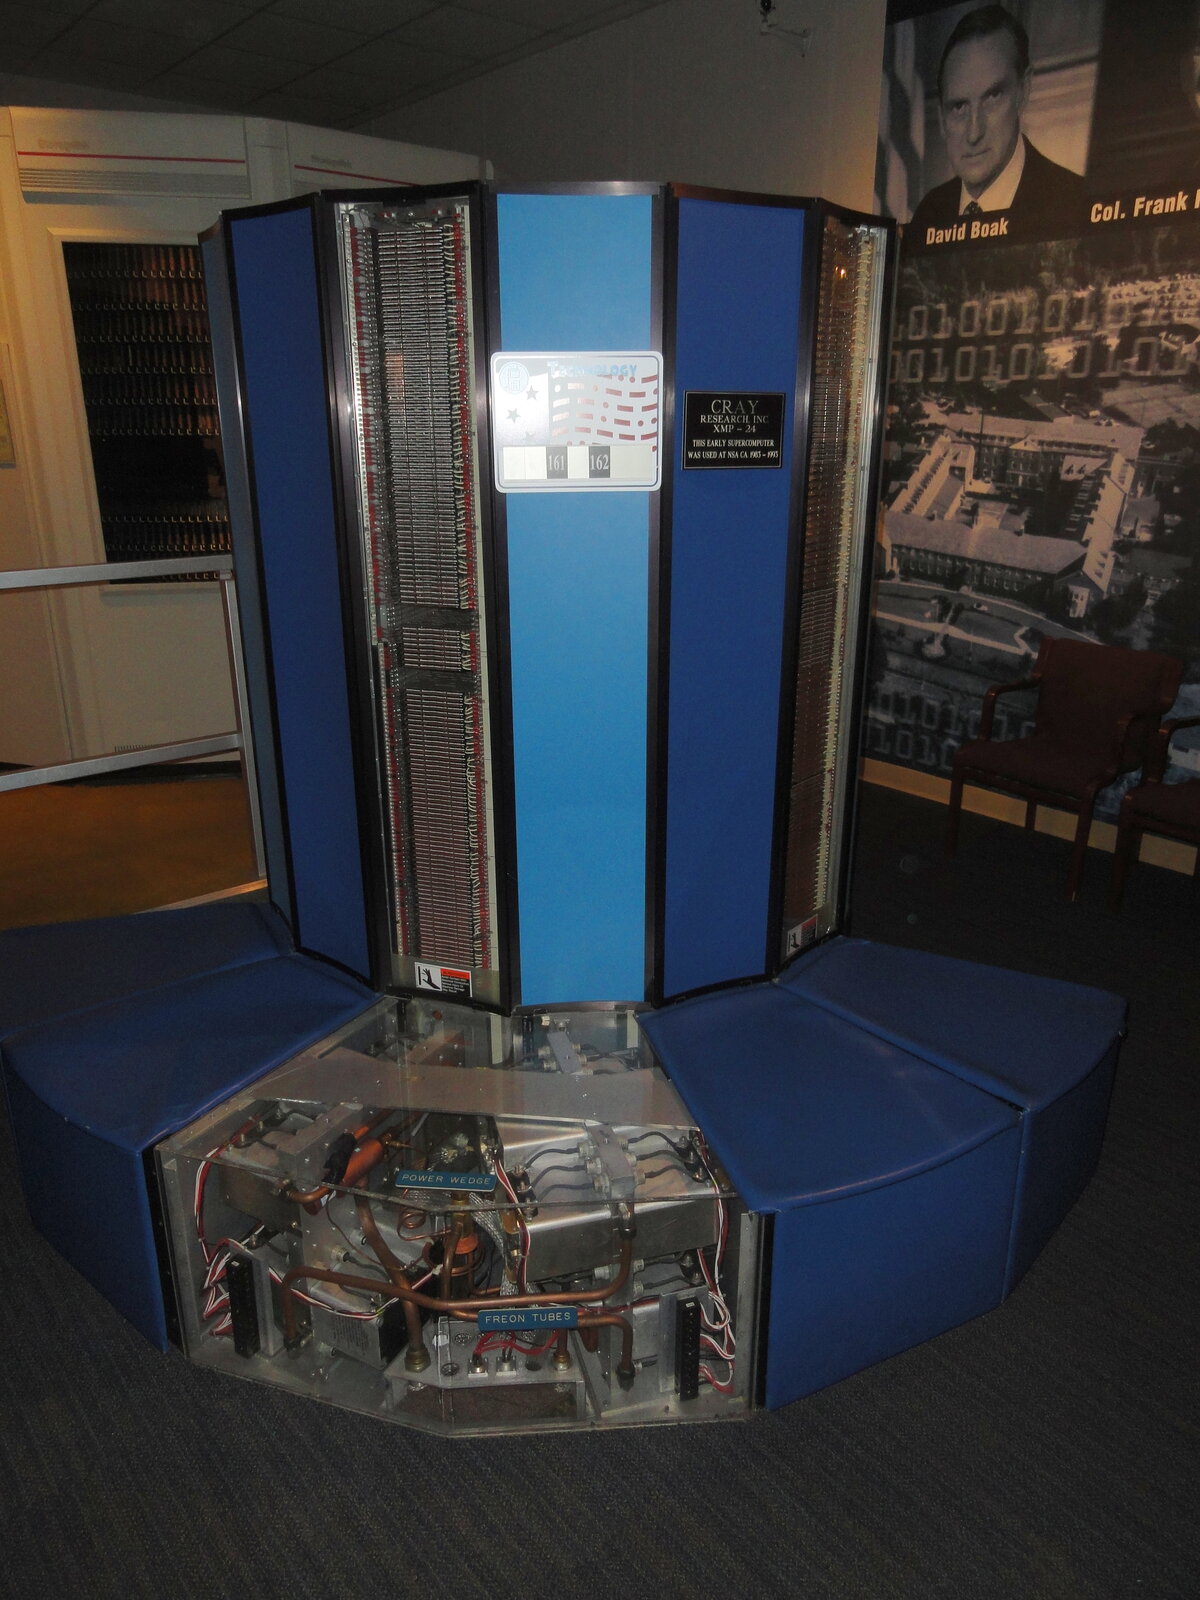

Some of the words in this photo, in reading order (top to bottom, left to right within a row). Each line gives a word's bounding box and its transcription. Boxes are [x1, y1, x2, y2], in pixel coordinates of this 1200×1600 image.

[1090, 200, 1126, 223] Col.
[1133, 190, 1189, 217] Frank
[926, 222, 967, 245] David
[970, 217, 1009, 239] Boak
[711, 399, 759, 414] CRAY
[700, 414, 750, 424] RESEARCH
[753, 415, 769, 424] INC
[713, 424, 734, 433] XMP
[745, 424, 756, 433] 24
[693, 439, 706, 448] THIS
[707, 439, 726, 447] EARLY
[590, 454, 609, 470] 162
[688, 451, 701, 459] WAS
[702, 451, 718, 459] USED
[718, 451, 726, 459] AT
[727, 451, 739, 459] NSA
[548, 454, 565, 471] 161
[402, 1173, 444, 1184] POWER
[450, 1176, 492, 1186] WEDGE
[485, 1314, 525, 1325] FREON
[532, 1311, 571, 1323] TUBES
